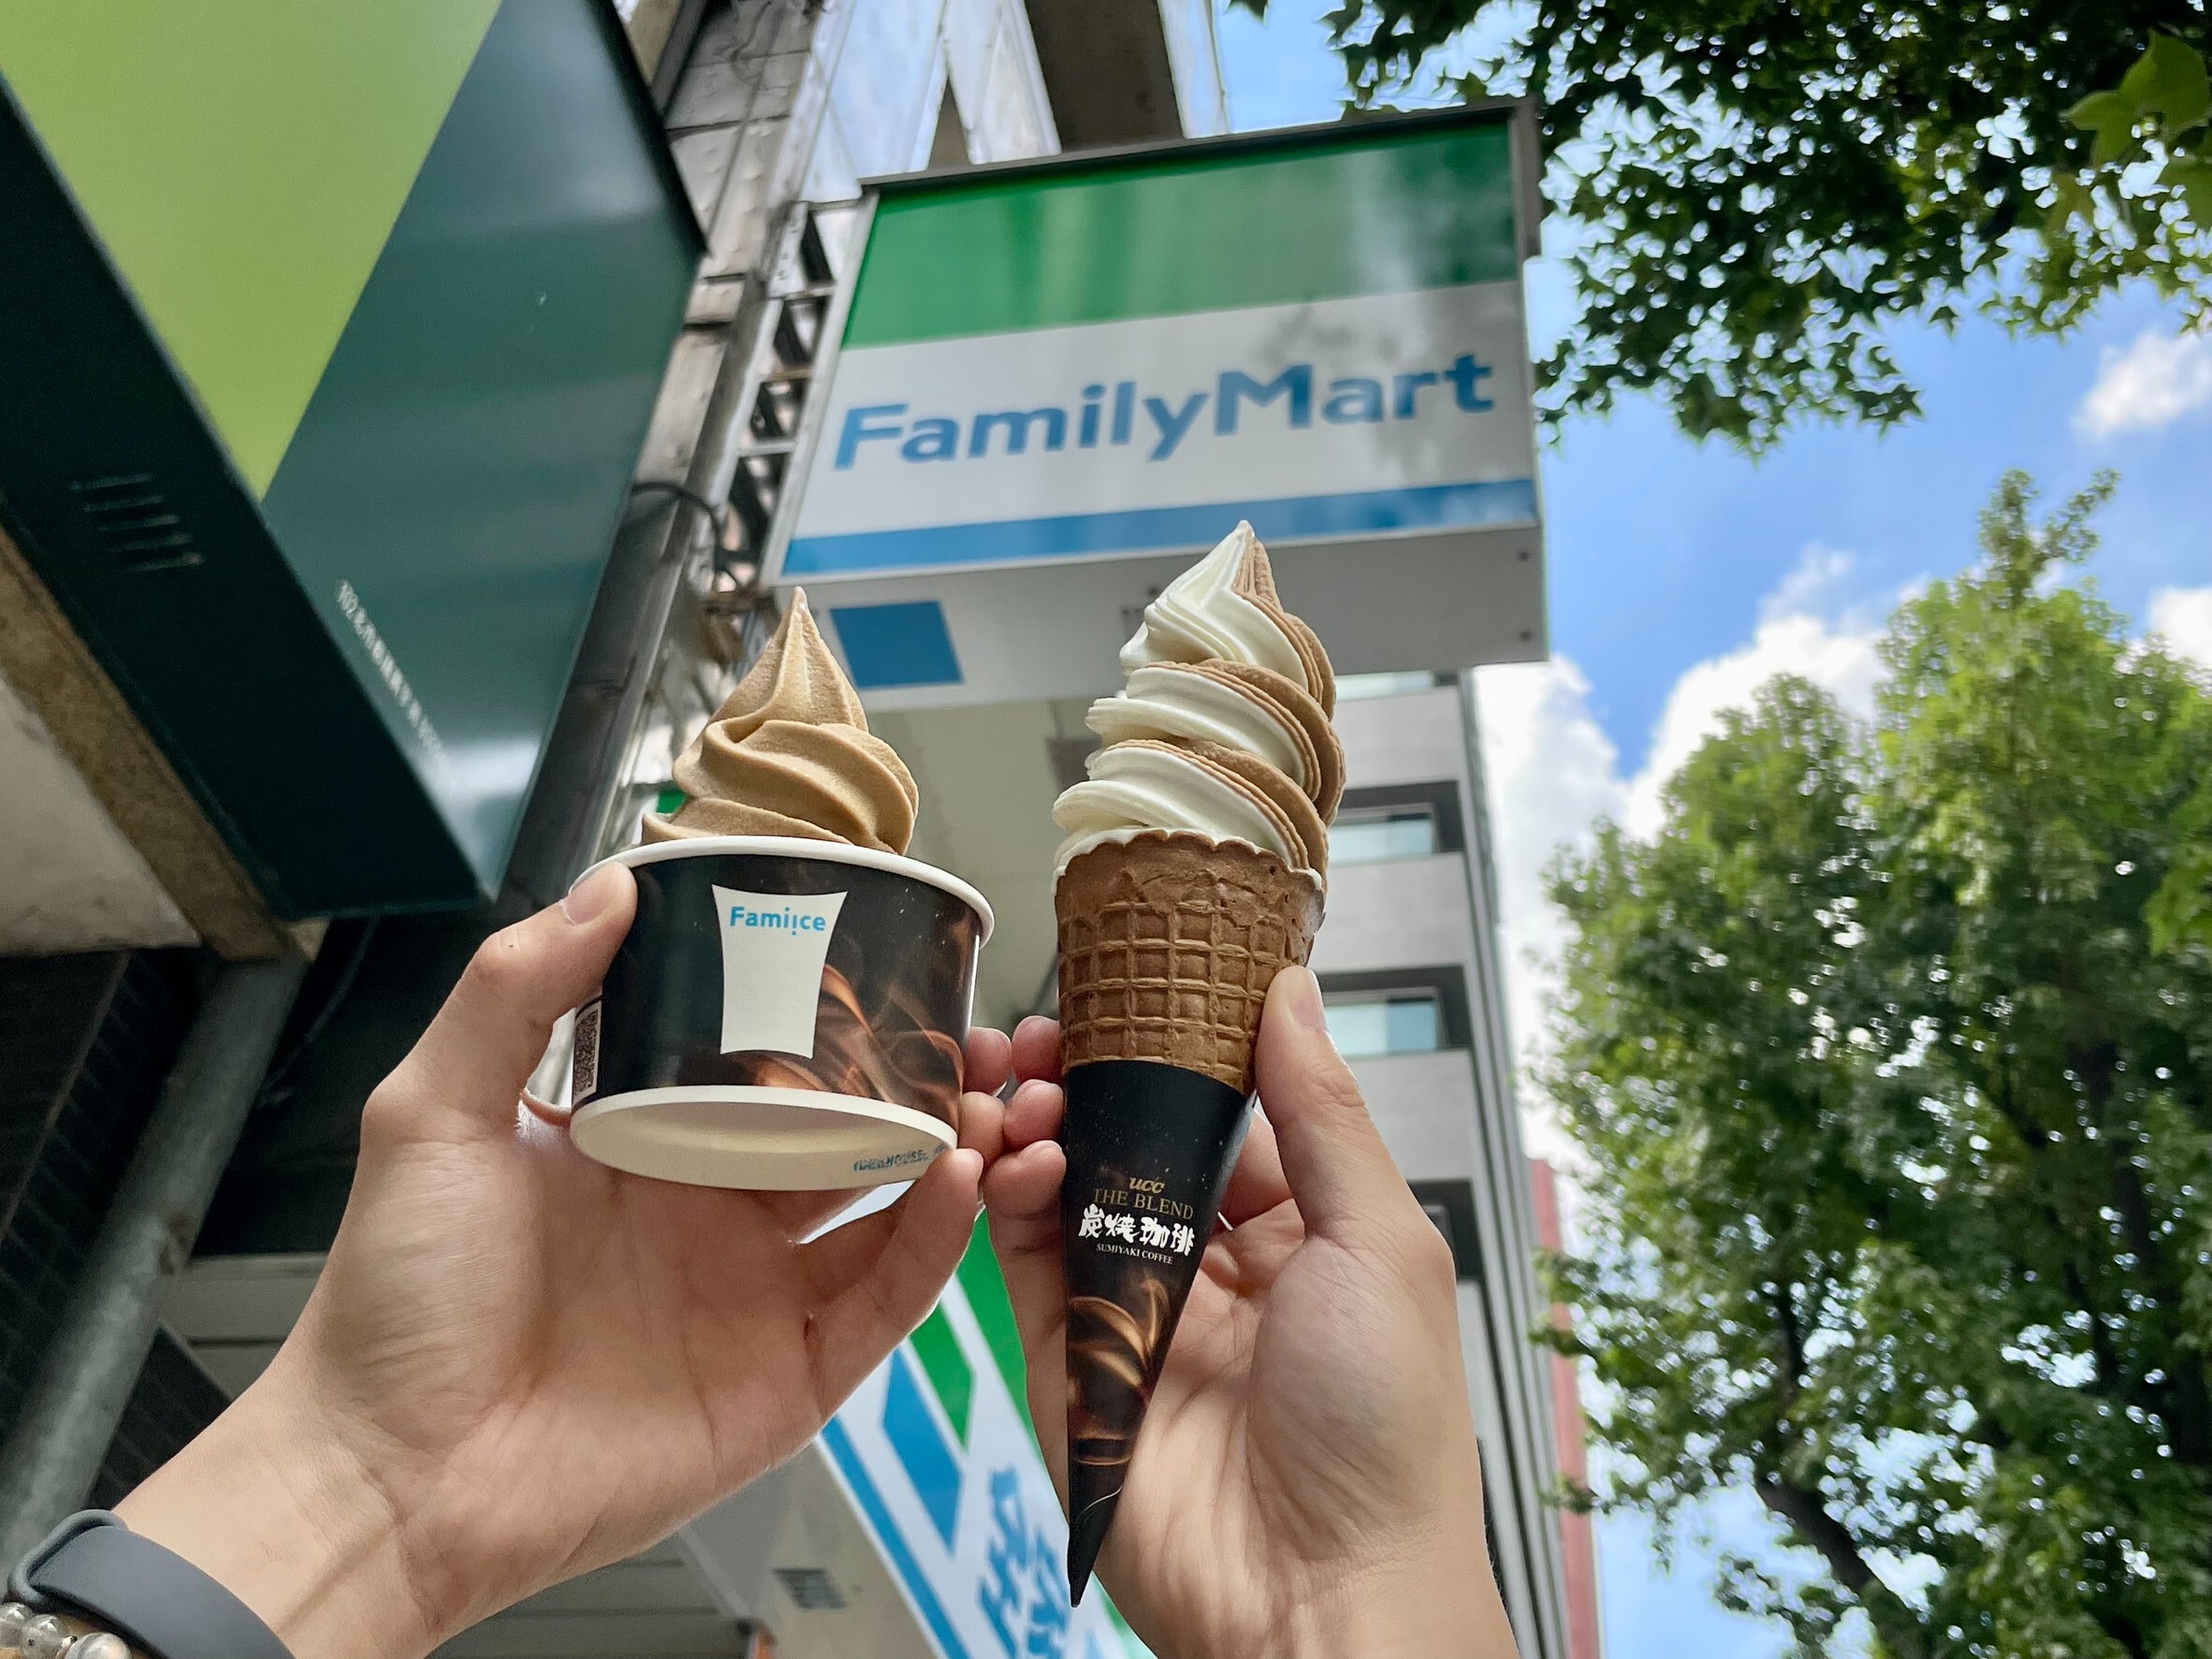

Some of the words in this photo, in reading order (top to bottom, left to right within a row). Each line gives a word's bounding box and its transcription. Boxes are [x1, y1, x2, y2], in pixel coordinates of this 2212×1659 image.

[832, 352, 1496, 470] FamilyMart
[1094, 1188, 1128, 1204] THE
[1134, 1193, 1194, 1219] BLEND
[1097, 1244, 1140, 1257] SUMIYAKI
[1142, 1250, 1173, 1264] COFFEE
